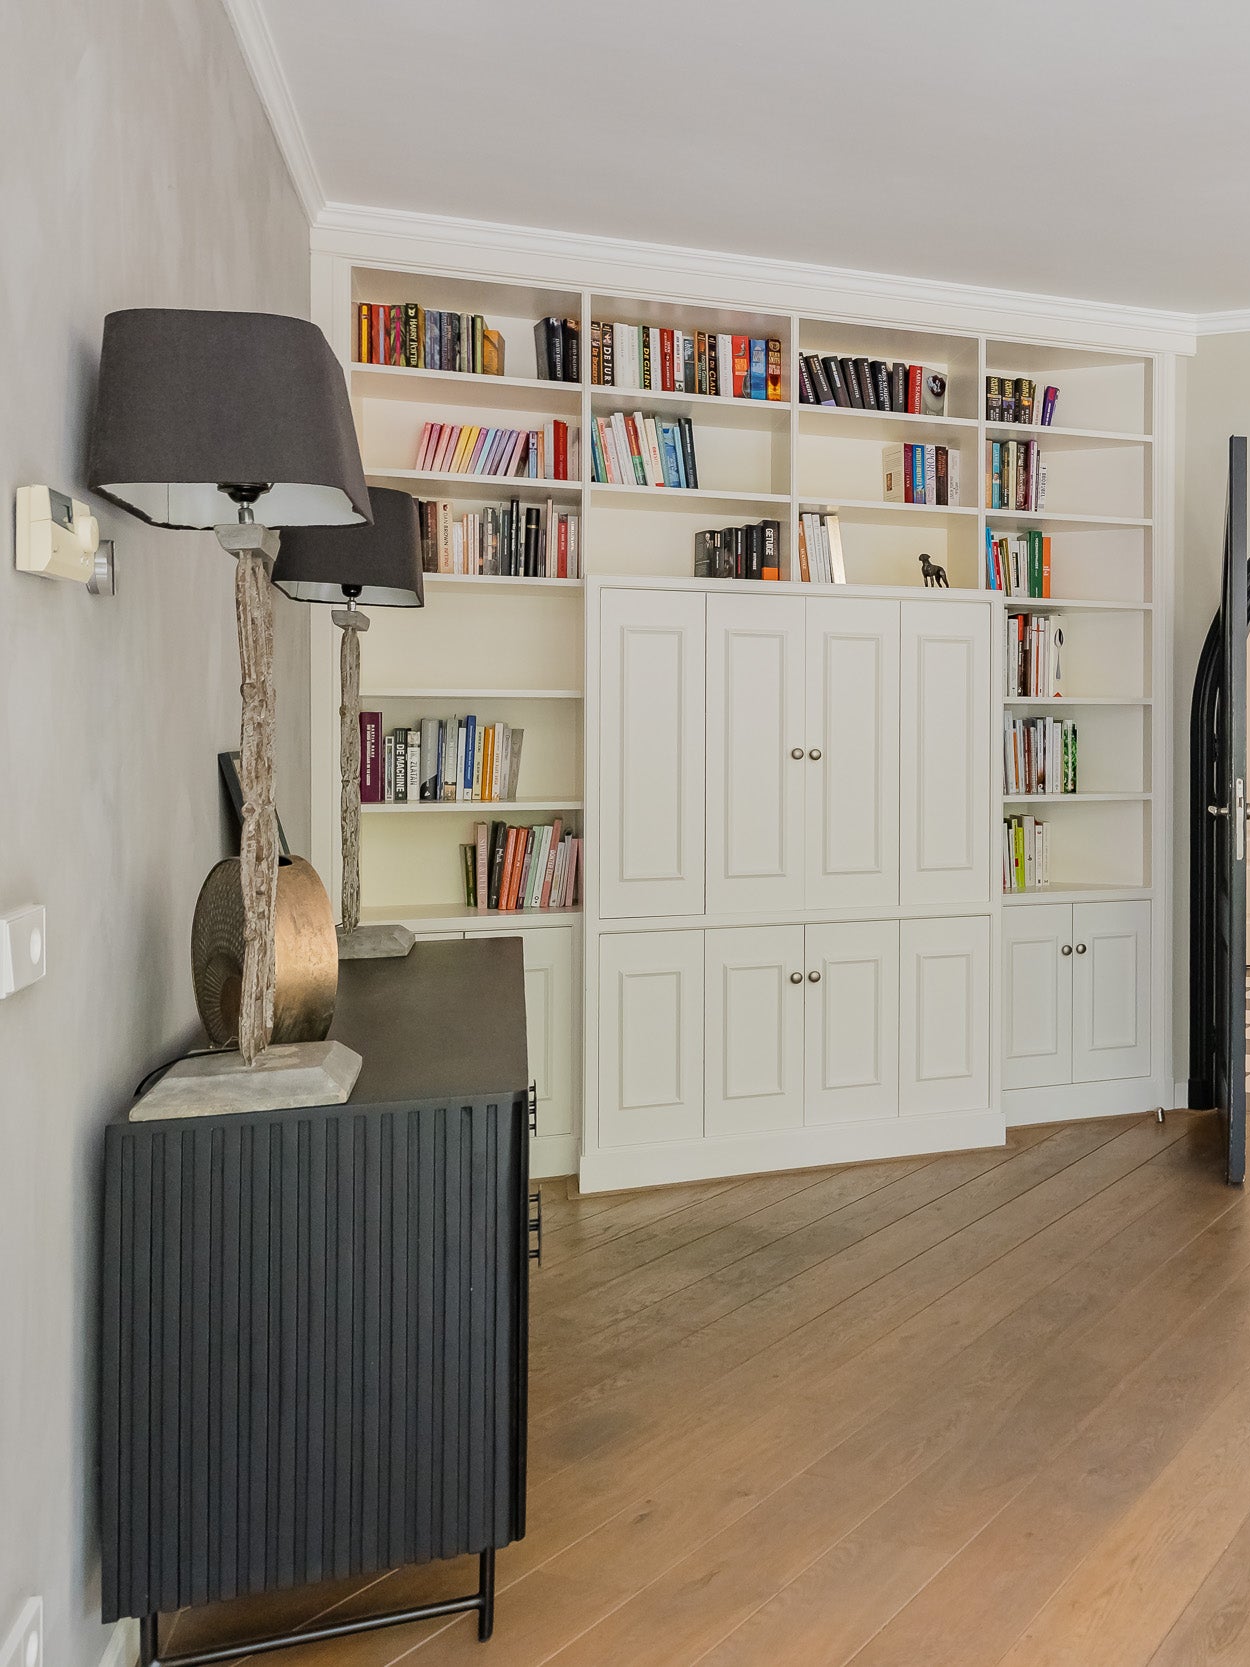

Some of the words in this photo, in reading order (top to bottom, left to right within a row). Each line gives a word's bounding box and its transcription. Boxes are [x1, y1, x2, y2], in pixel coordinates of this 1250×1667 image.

[409, 318, 418, 341] HARRY
[410, 342, 418, 366] POTTER
[604, 347, 612, 360] DE
[644, 348, 650, 359] DE
[765, 528, 774, 556] GETUIGE
[396, 744, 405, 755] DE
[396, 756, 405, 792] MACHINE
[410, 761, 418, 786] ZLATAN
